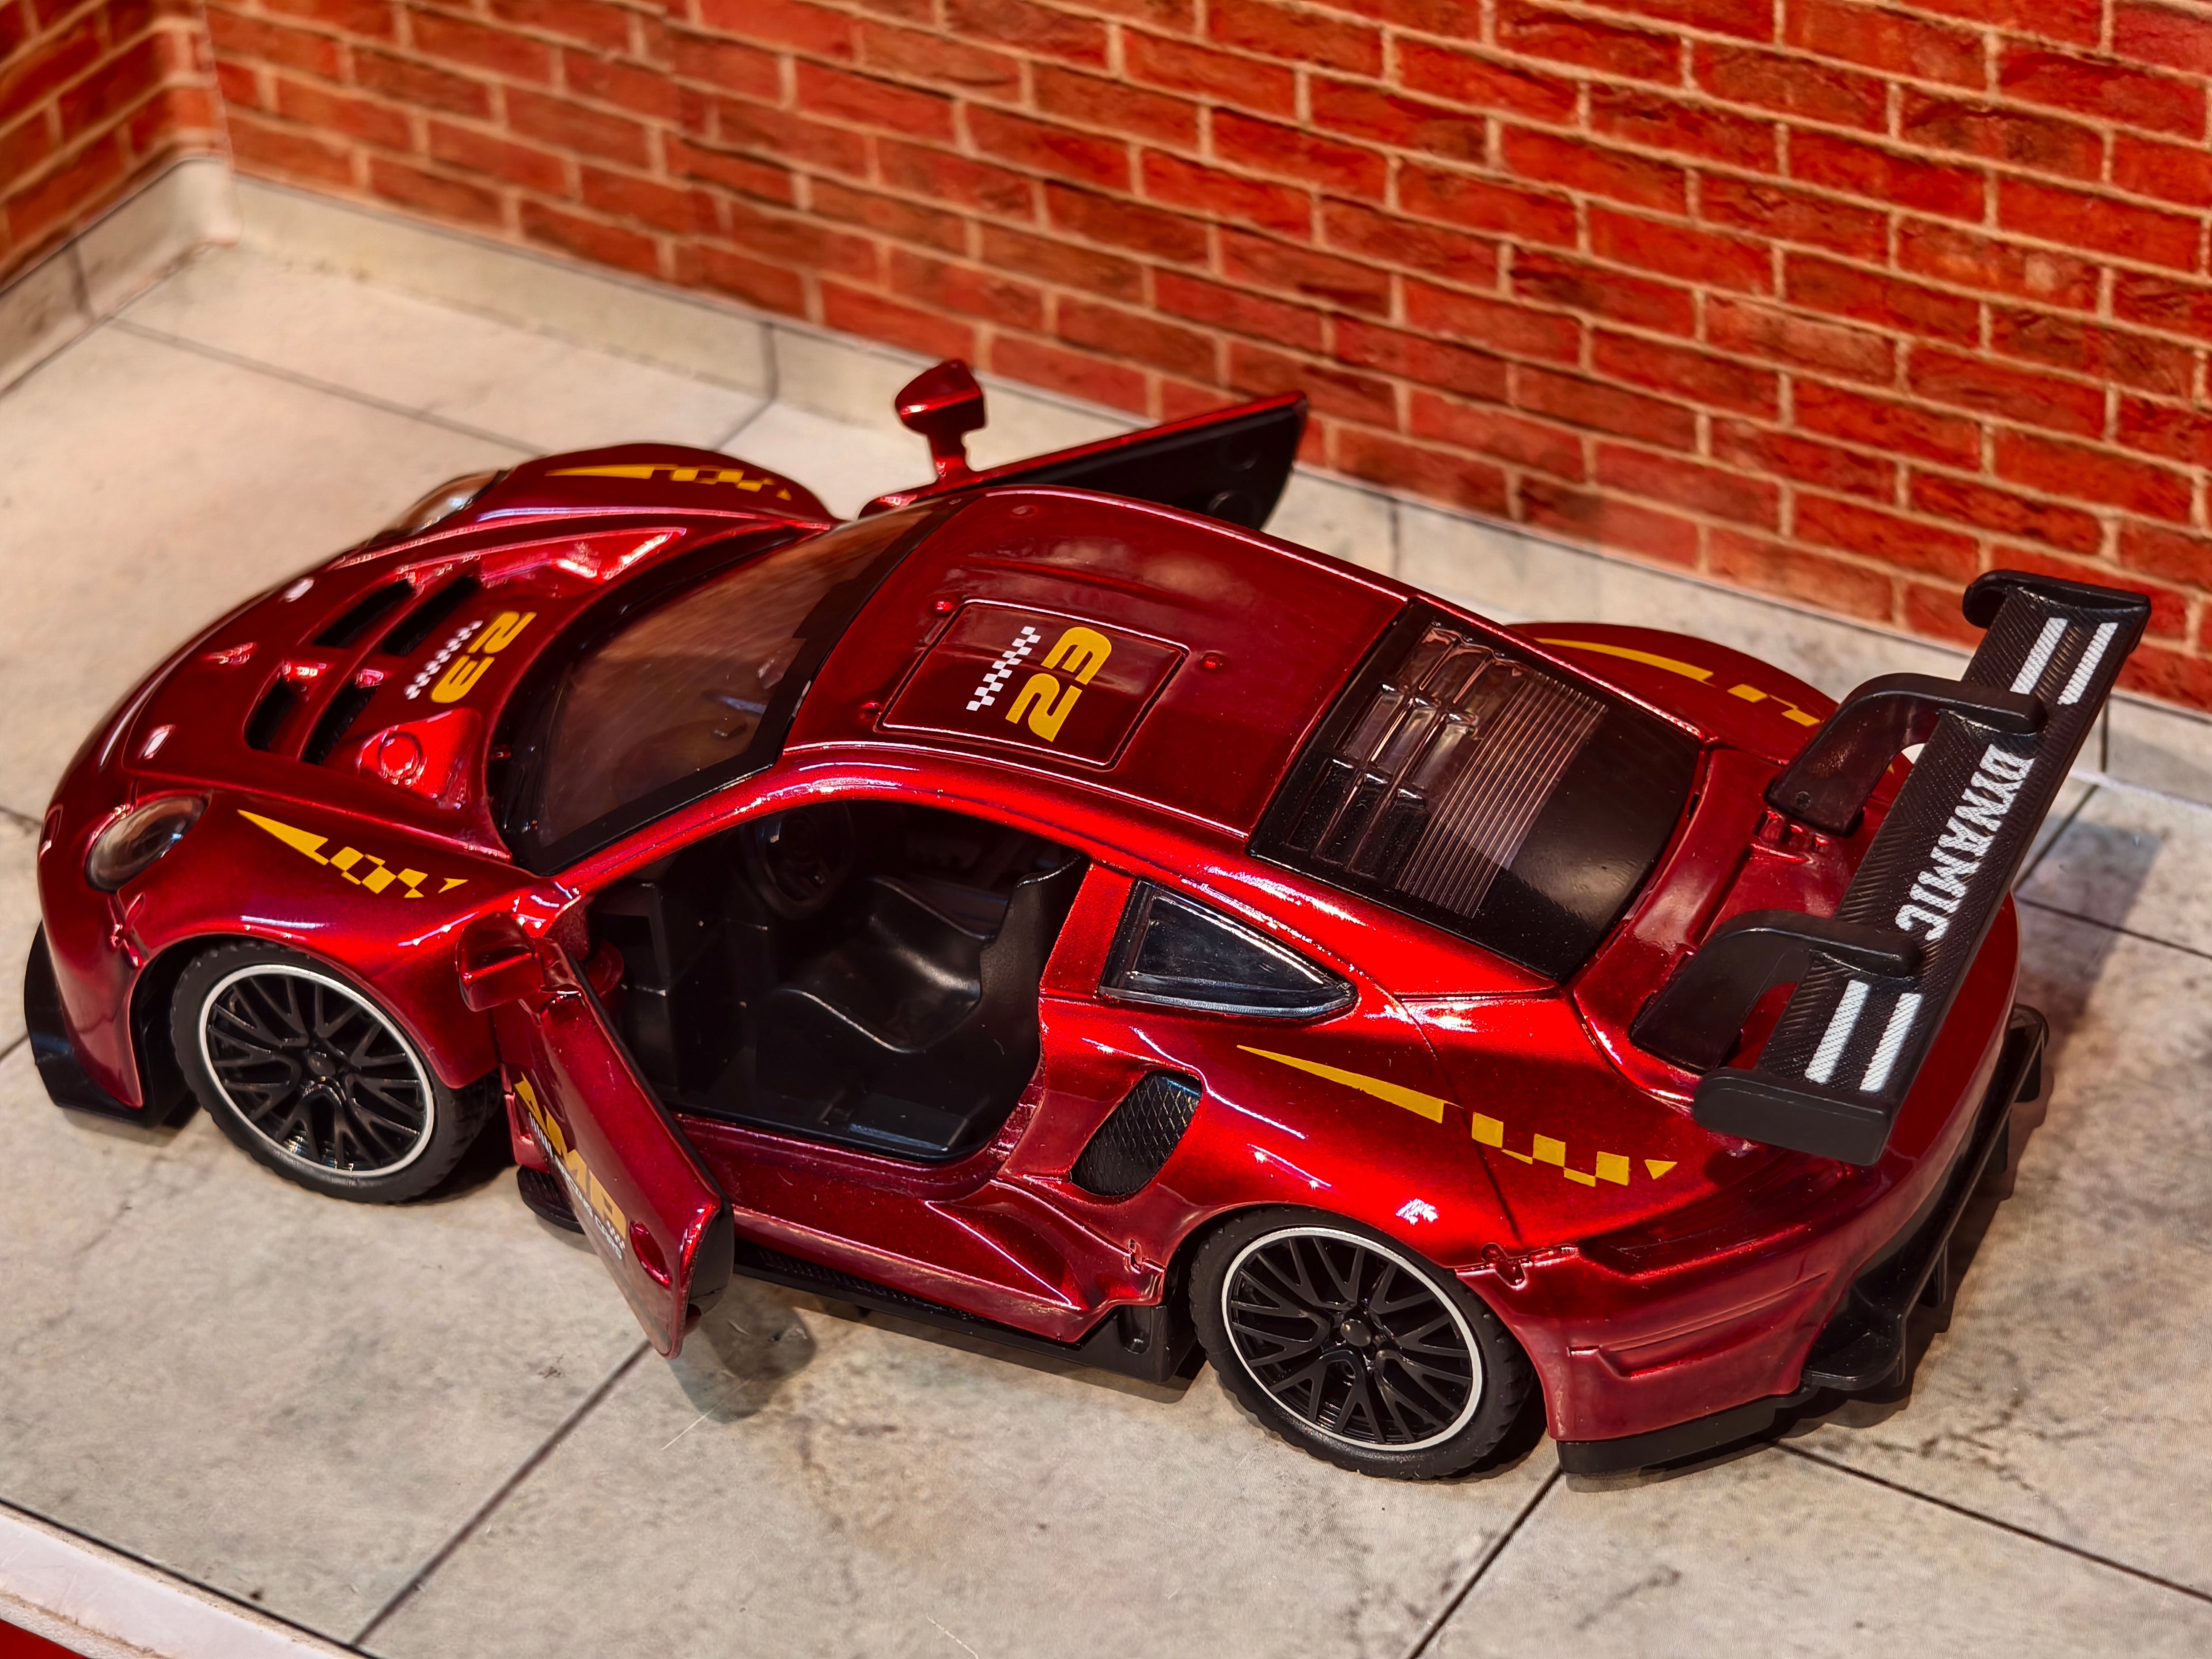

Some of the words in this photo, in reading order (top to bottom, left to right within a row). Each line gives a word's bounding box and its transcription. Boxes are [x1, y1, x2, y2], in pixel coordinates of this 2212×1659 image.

[430, 611, 537, 703] 23
[1005, 626, 1112, 743] 23
[1895, 744, 2036, 941] DYNAMIC
[514, 1071, 627, 1240] AMP
